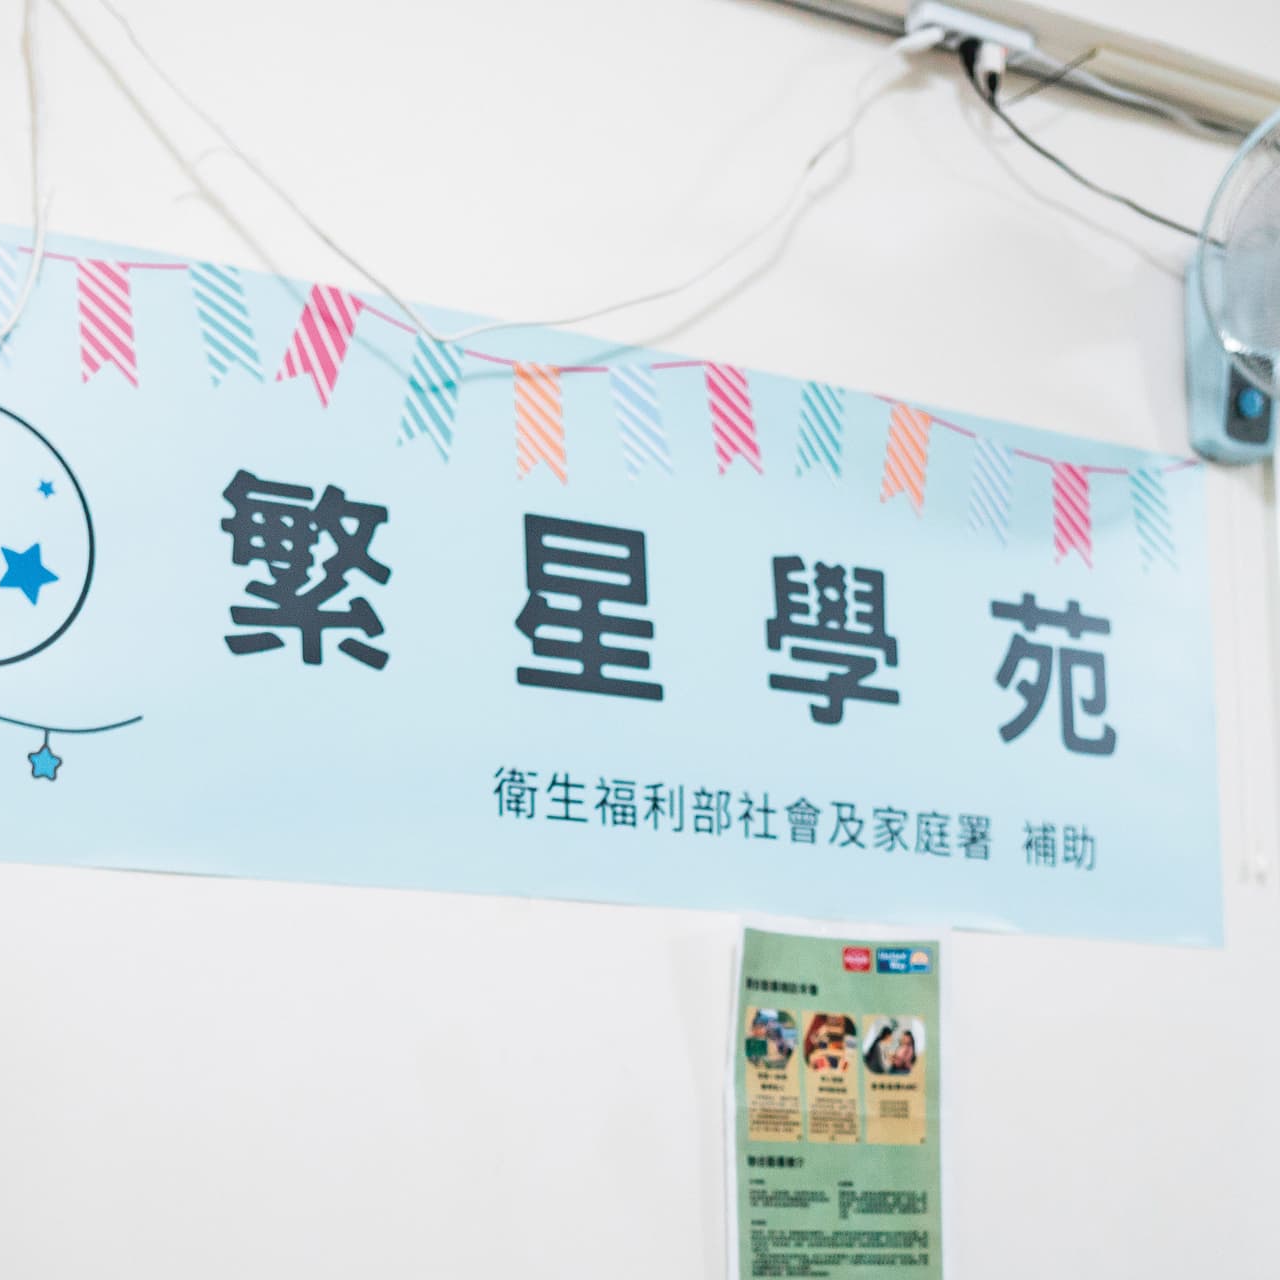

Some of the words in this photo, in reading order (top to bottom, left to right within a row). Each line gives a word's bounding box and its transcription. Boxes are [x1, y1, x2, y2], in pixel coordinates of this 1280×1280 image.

[220, 467, 1117, 756] 繁星學苑
[492, 766, 993, 862] 衛生福利部社會及家庭署
[1021, 820, 1097, 871] 補助
